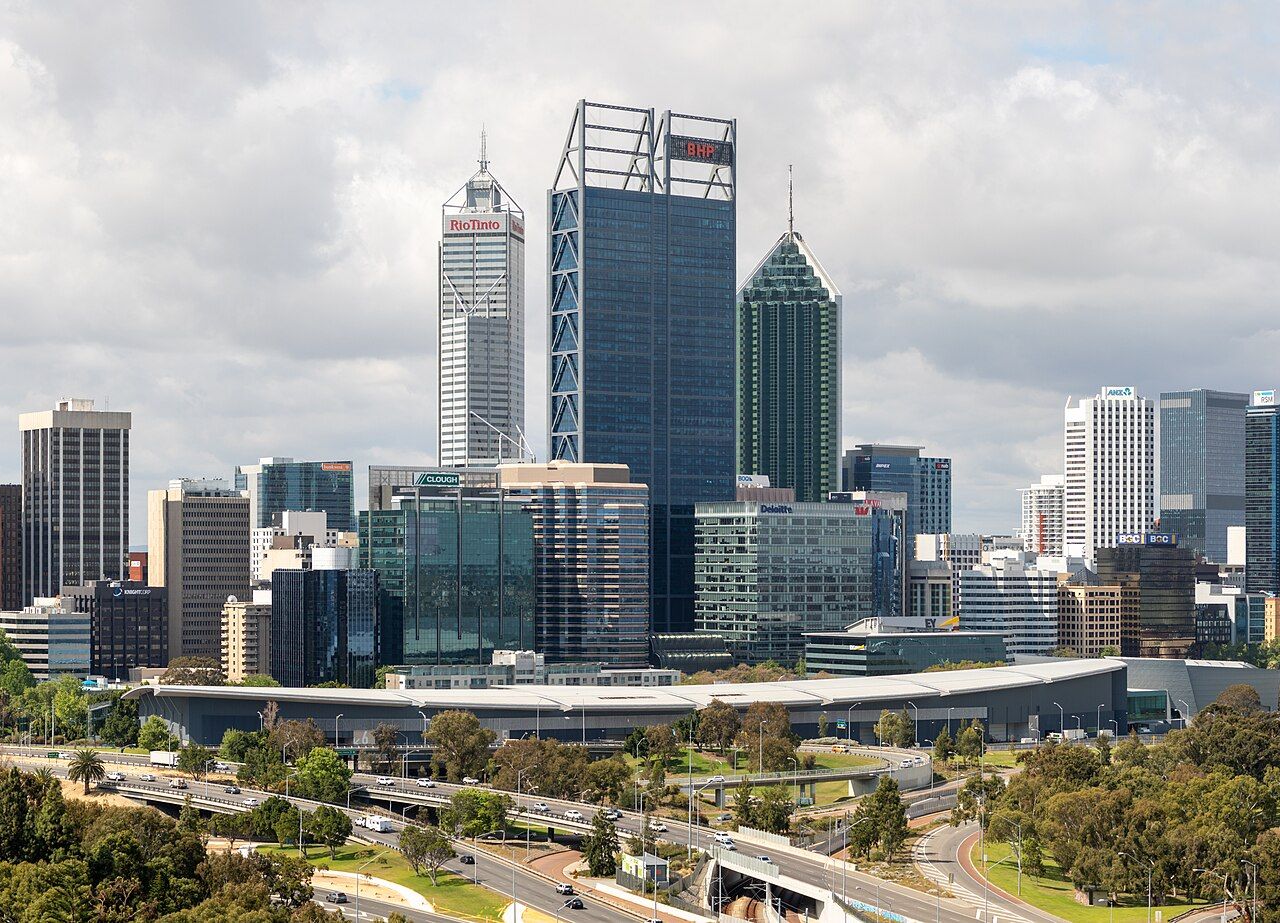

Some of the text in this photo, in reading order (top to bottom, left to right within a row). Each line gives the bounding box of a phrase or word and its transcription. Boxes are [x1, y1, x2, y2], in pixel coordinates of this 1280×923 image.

[687, 142, 716, 157] BHP
[450, 219, 500, 231] RioTinto
[761, 504, 793, 513] Deloitte
[1119, 534, 1141, 543] BGC
[1150, 535, 1169, 543] BGC
[925, 618, 937, 628] EY
